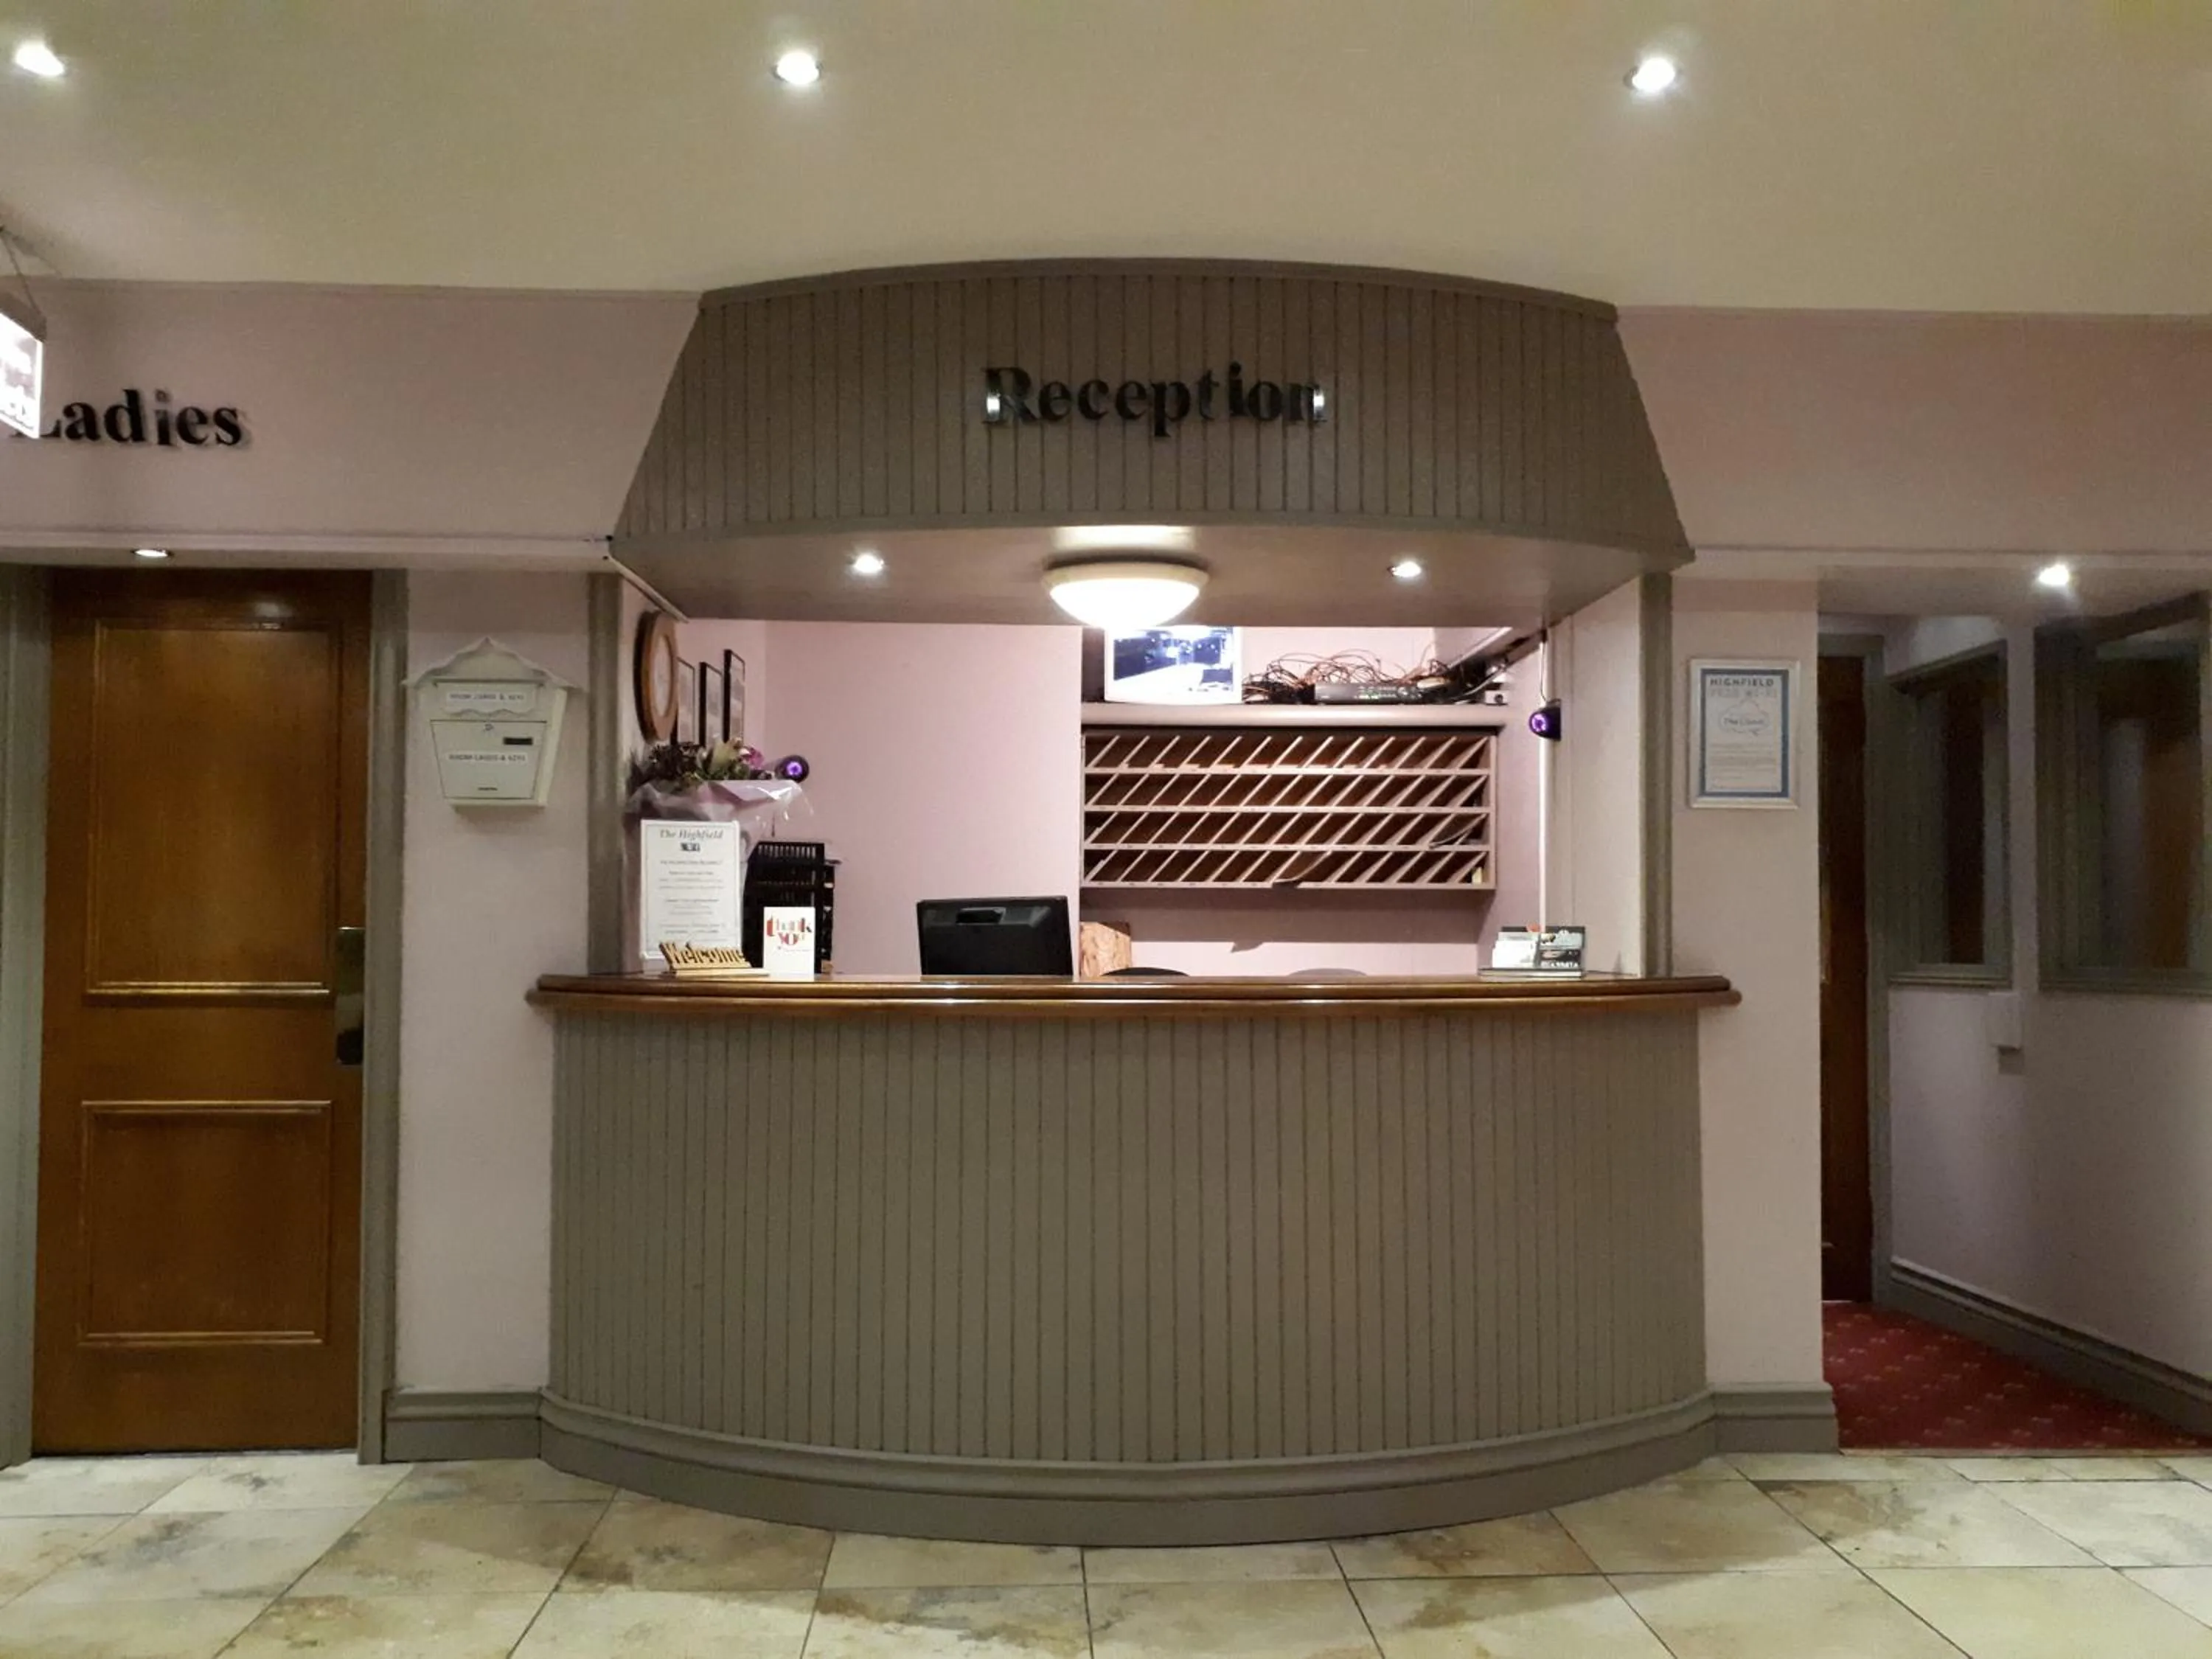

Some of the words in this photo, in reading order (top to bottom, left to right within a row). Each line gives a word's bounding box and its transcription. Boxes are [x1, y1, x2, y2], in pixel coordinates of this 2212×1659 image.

[981, 361, 1327, 438] Reception
[1710, 678, 1774, 686] HIGHFIELD
[660, 829, 676, 838] The
[678, 829, 723, 841] Highfield
[659, 942, 745, 964] Welcome
